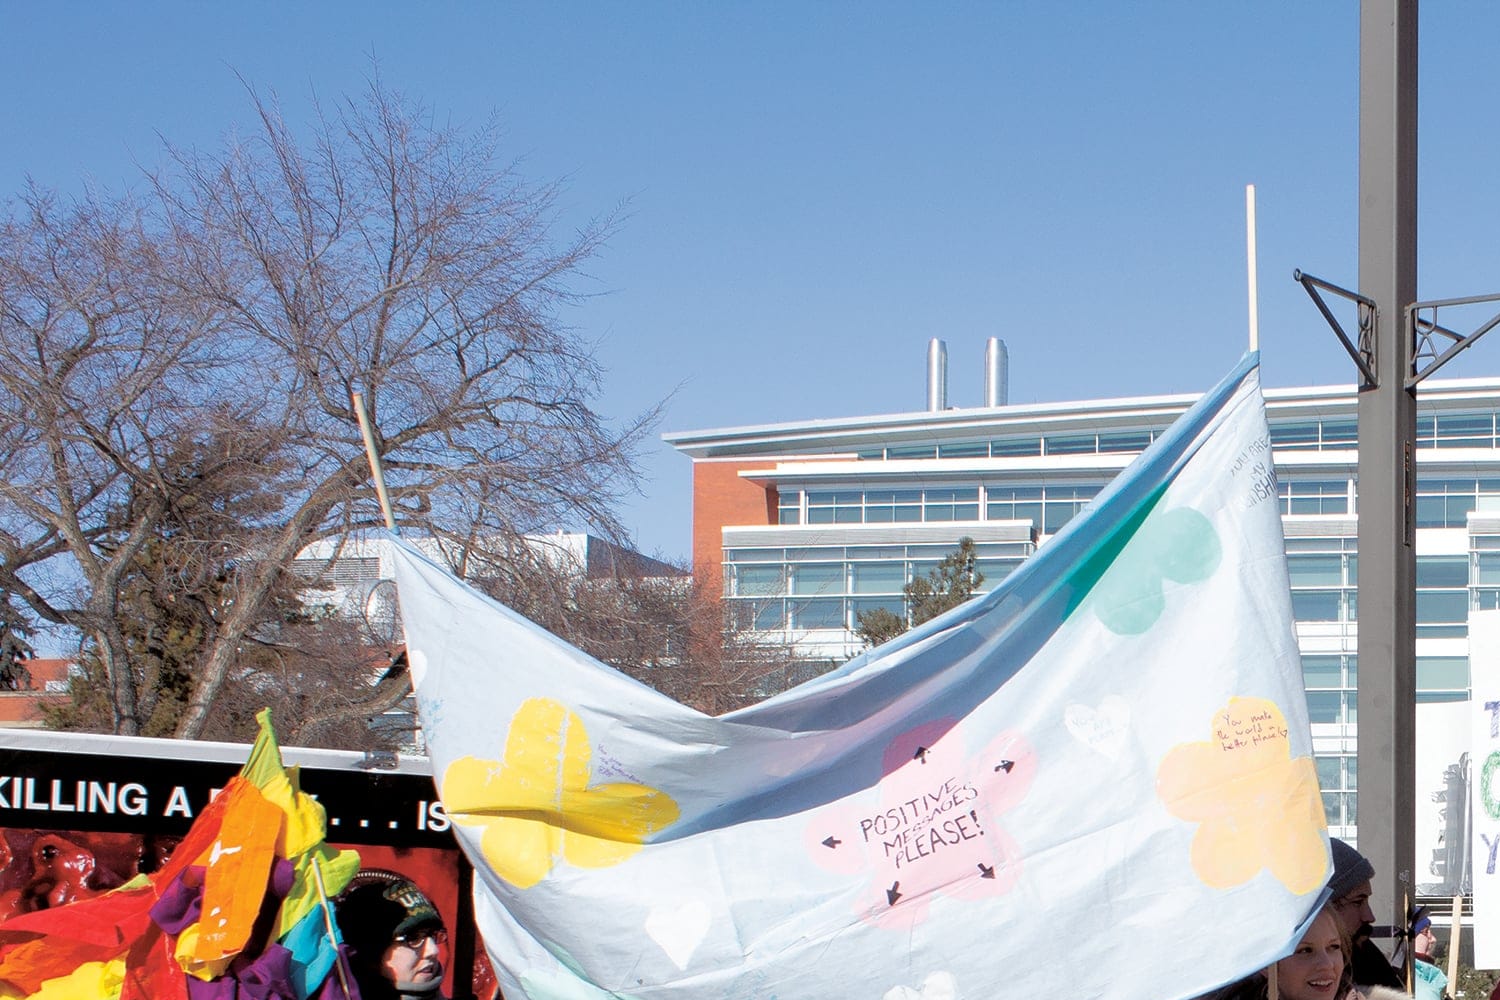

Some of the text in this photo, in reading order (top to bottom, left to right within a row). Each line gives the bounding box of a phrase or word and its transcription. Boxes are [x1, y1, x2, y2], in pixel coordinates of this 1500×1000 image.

[1249, 461, 1267, 481] MY
[163, 786, 193, 817] A
[417, 800, 451, 832] IS
[860, 777, 956, 842] POSITIVE
[883, 781, 978, 857] MESSAGES
[896, 810, 984, 869] PLEASE!
